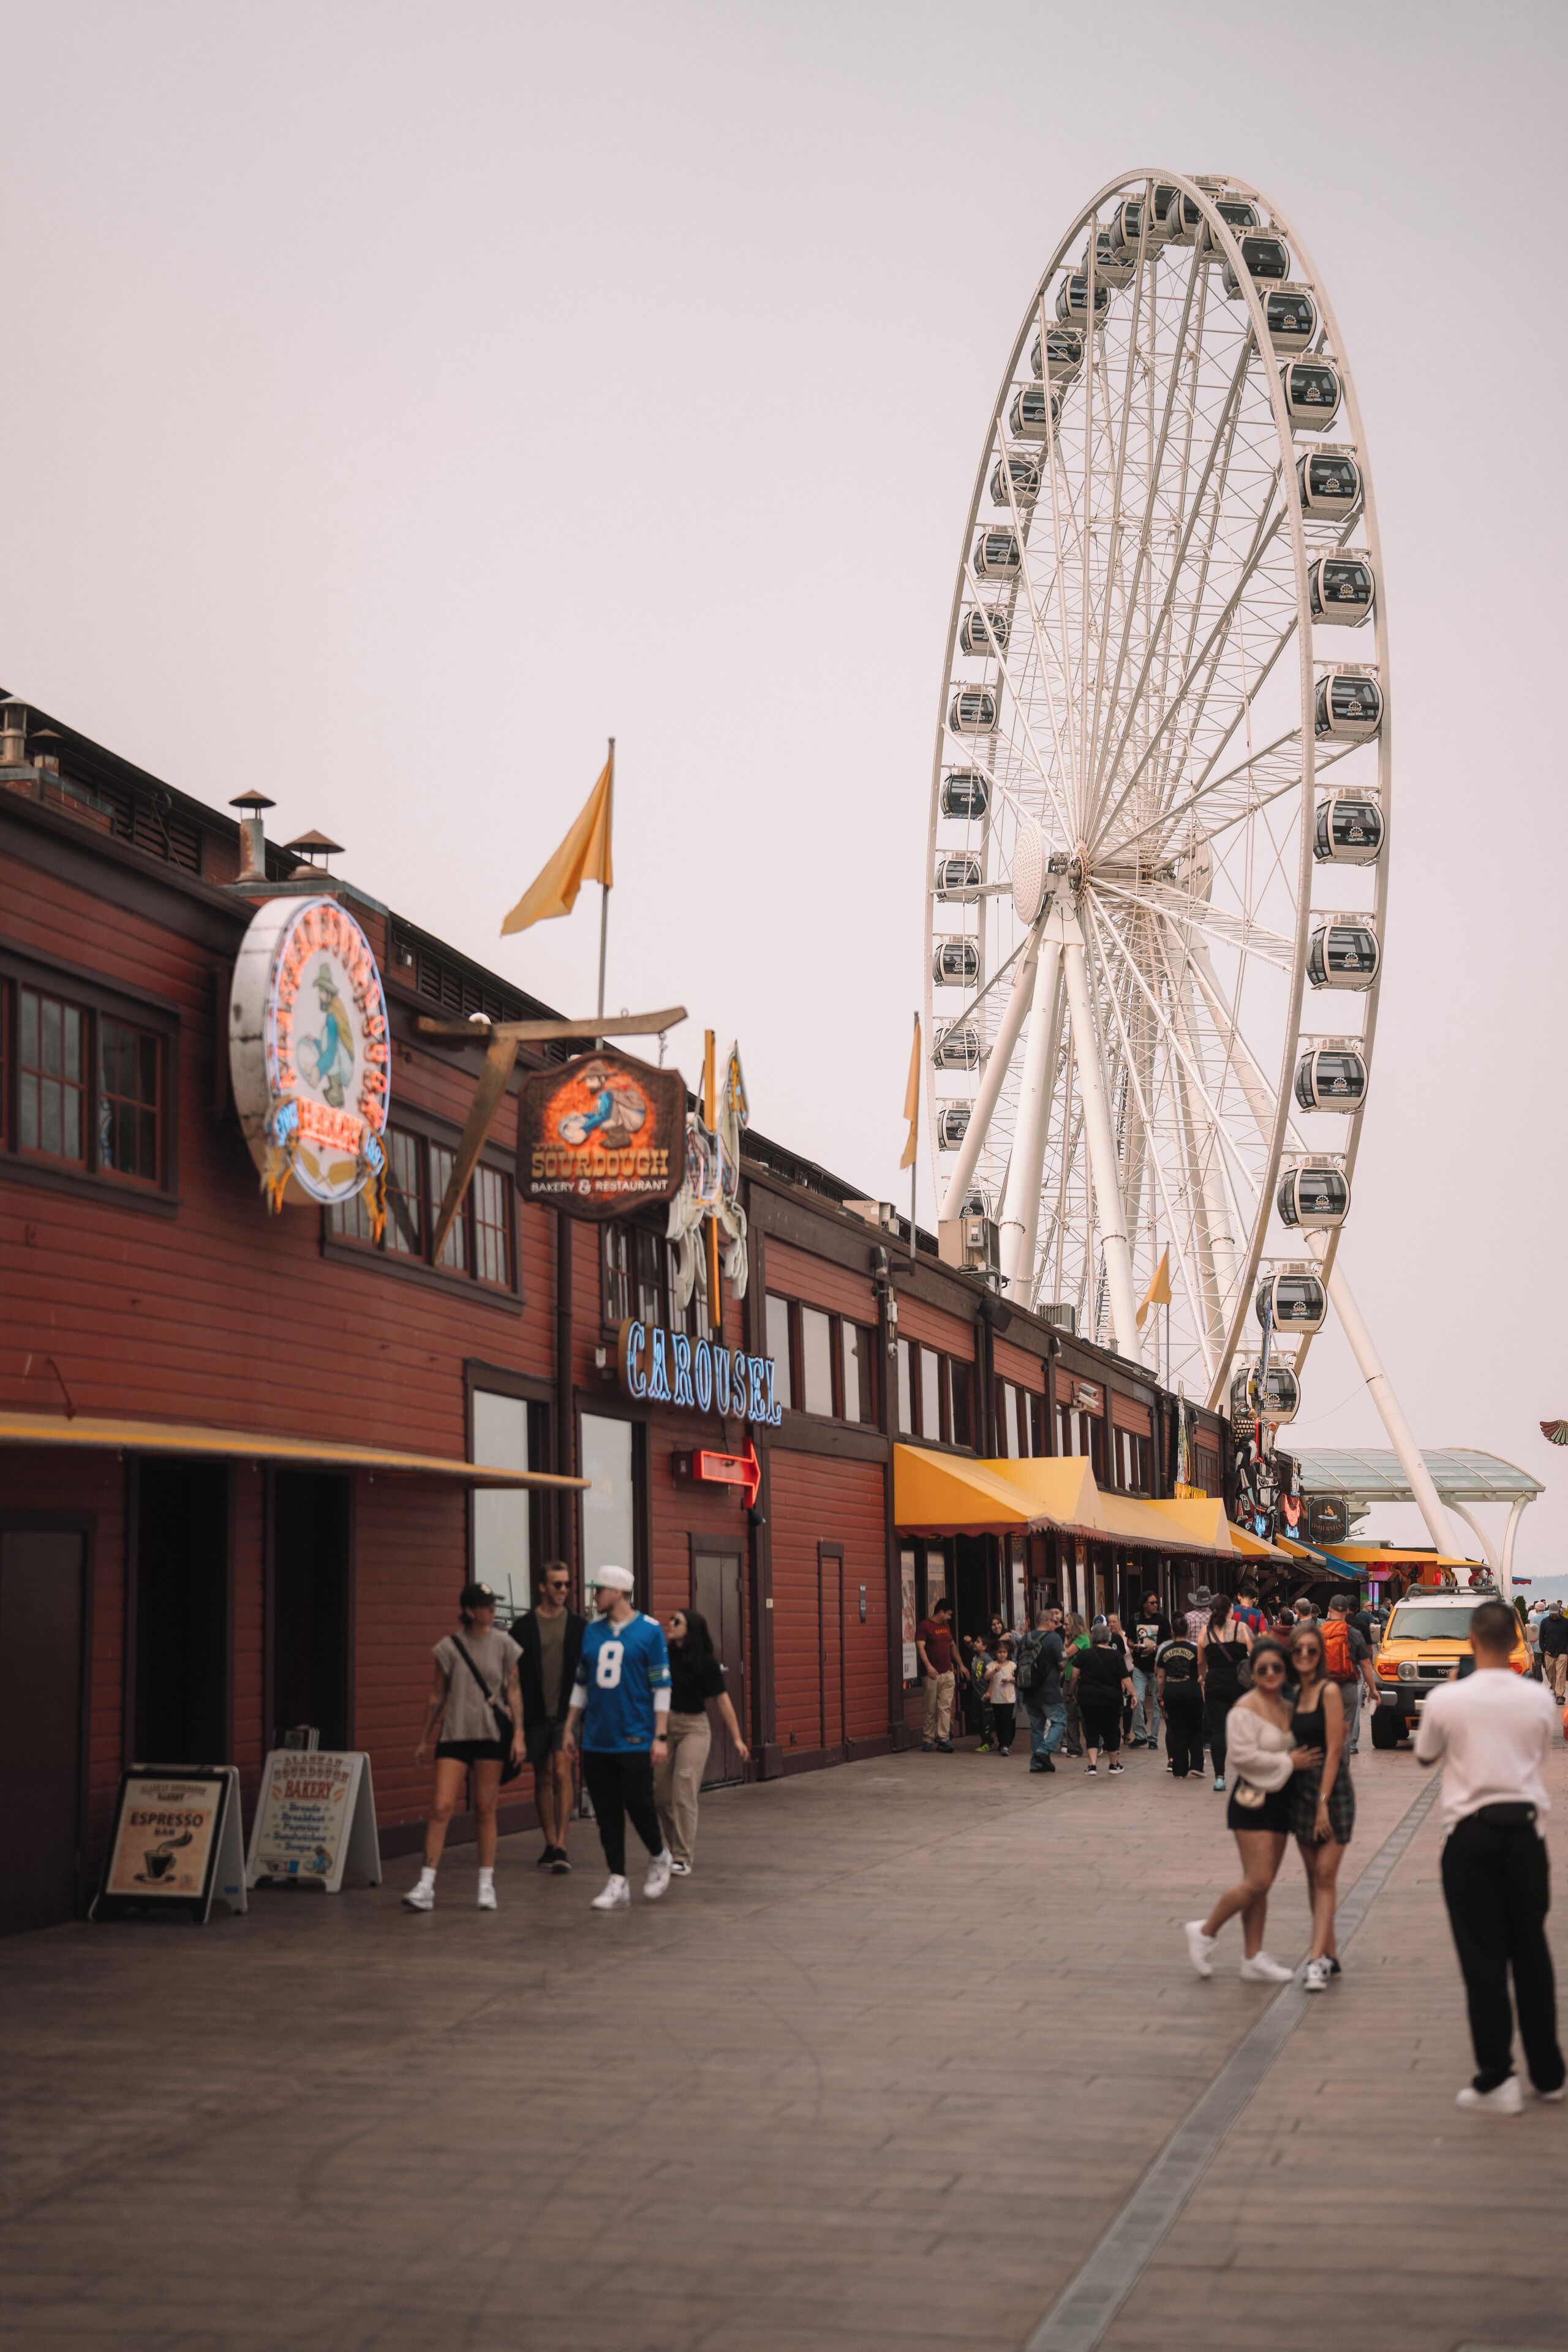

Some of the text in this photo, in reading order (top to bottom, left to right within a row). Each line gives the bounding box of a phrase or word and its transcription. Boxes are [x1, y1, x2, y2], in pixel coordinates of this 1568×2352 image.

[531, 1148, 669, 1178] SOURDOUGH
[531, 1178, 668, 1195] BAKERY & RESTAURANT
[620, 1319, 782, 1427] CAROUSEL
[596, 1640, 624, 1689] 8
[284, 1755, 343, 1768] ALASKAN
[274, 1765, 350, 1782] SOURDOUGH
[284, 1779, 334, 1800] BAKERY
[130, 1812, 203, 1828] ESPRESSO
